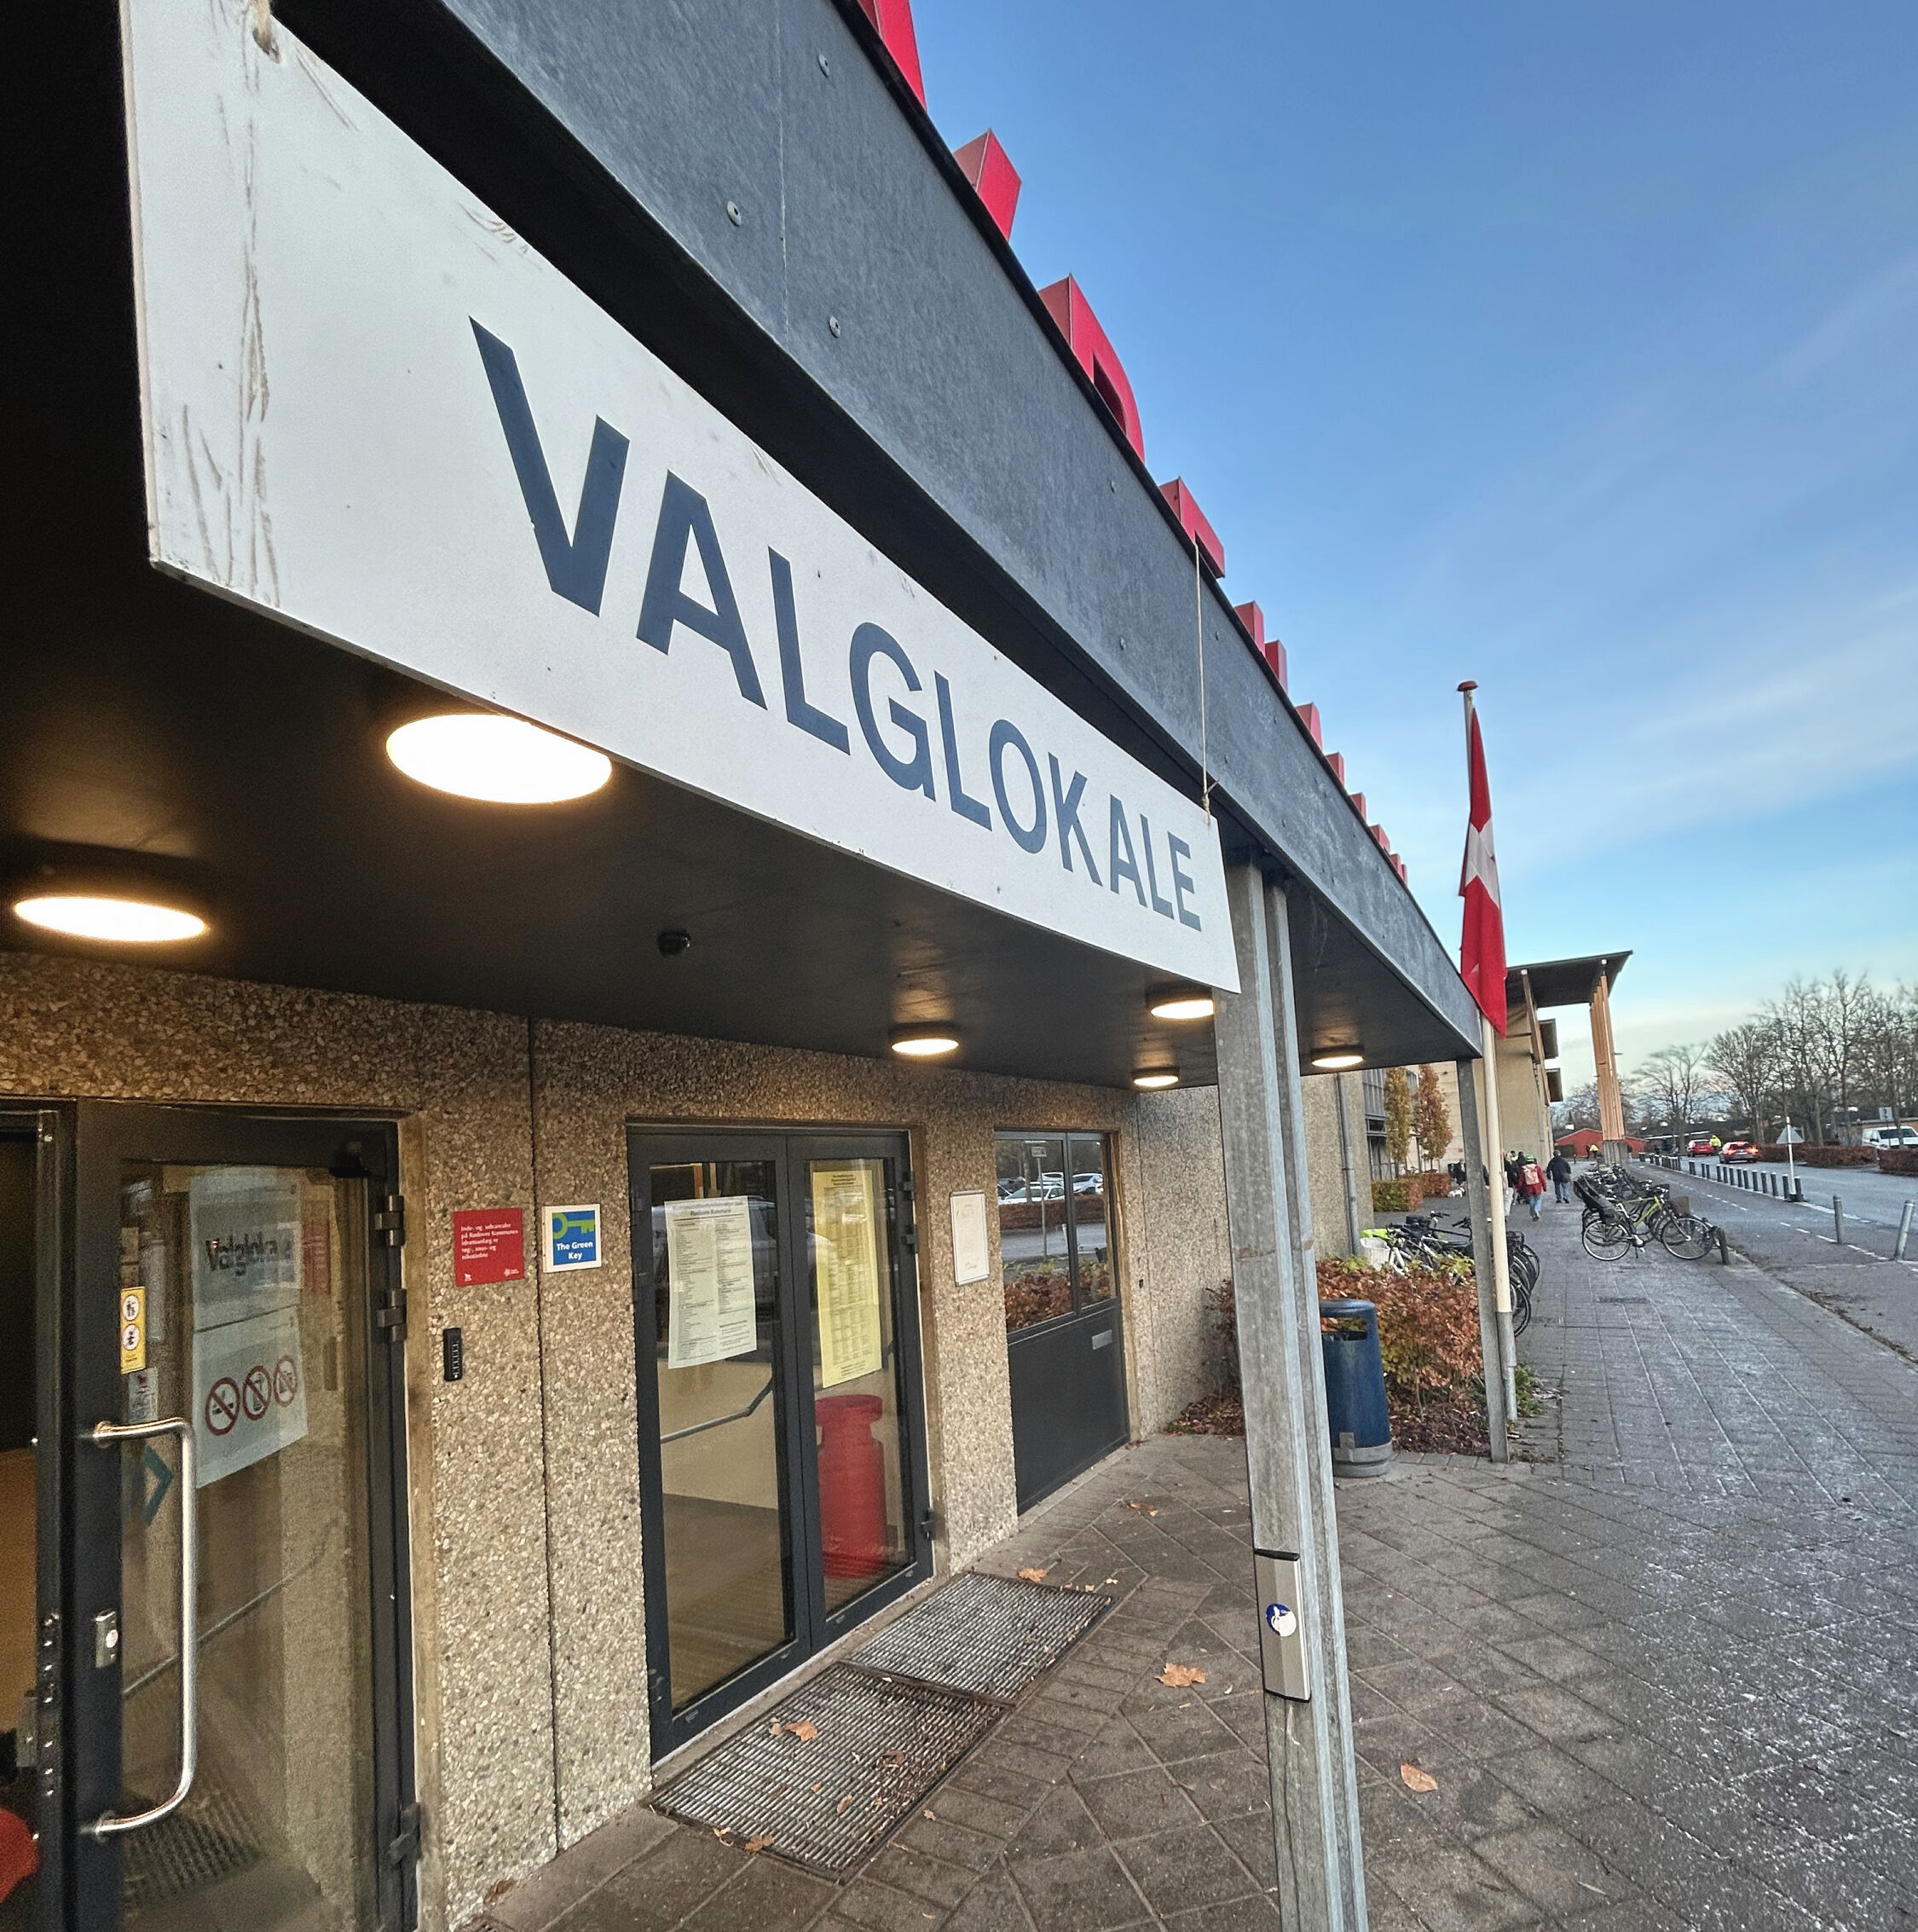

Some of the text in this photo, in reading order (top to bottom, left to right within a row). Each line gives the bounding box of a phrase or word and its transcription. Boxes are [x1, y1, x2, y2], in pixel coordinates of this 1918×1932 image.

[469, 315, 1202, 932] VALGLOKALE
[557, 1242, 570, 1251] The
[568, 1252, 582, 1260] Key
